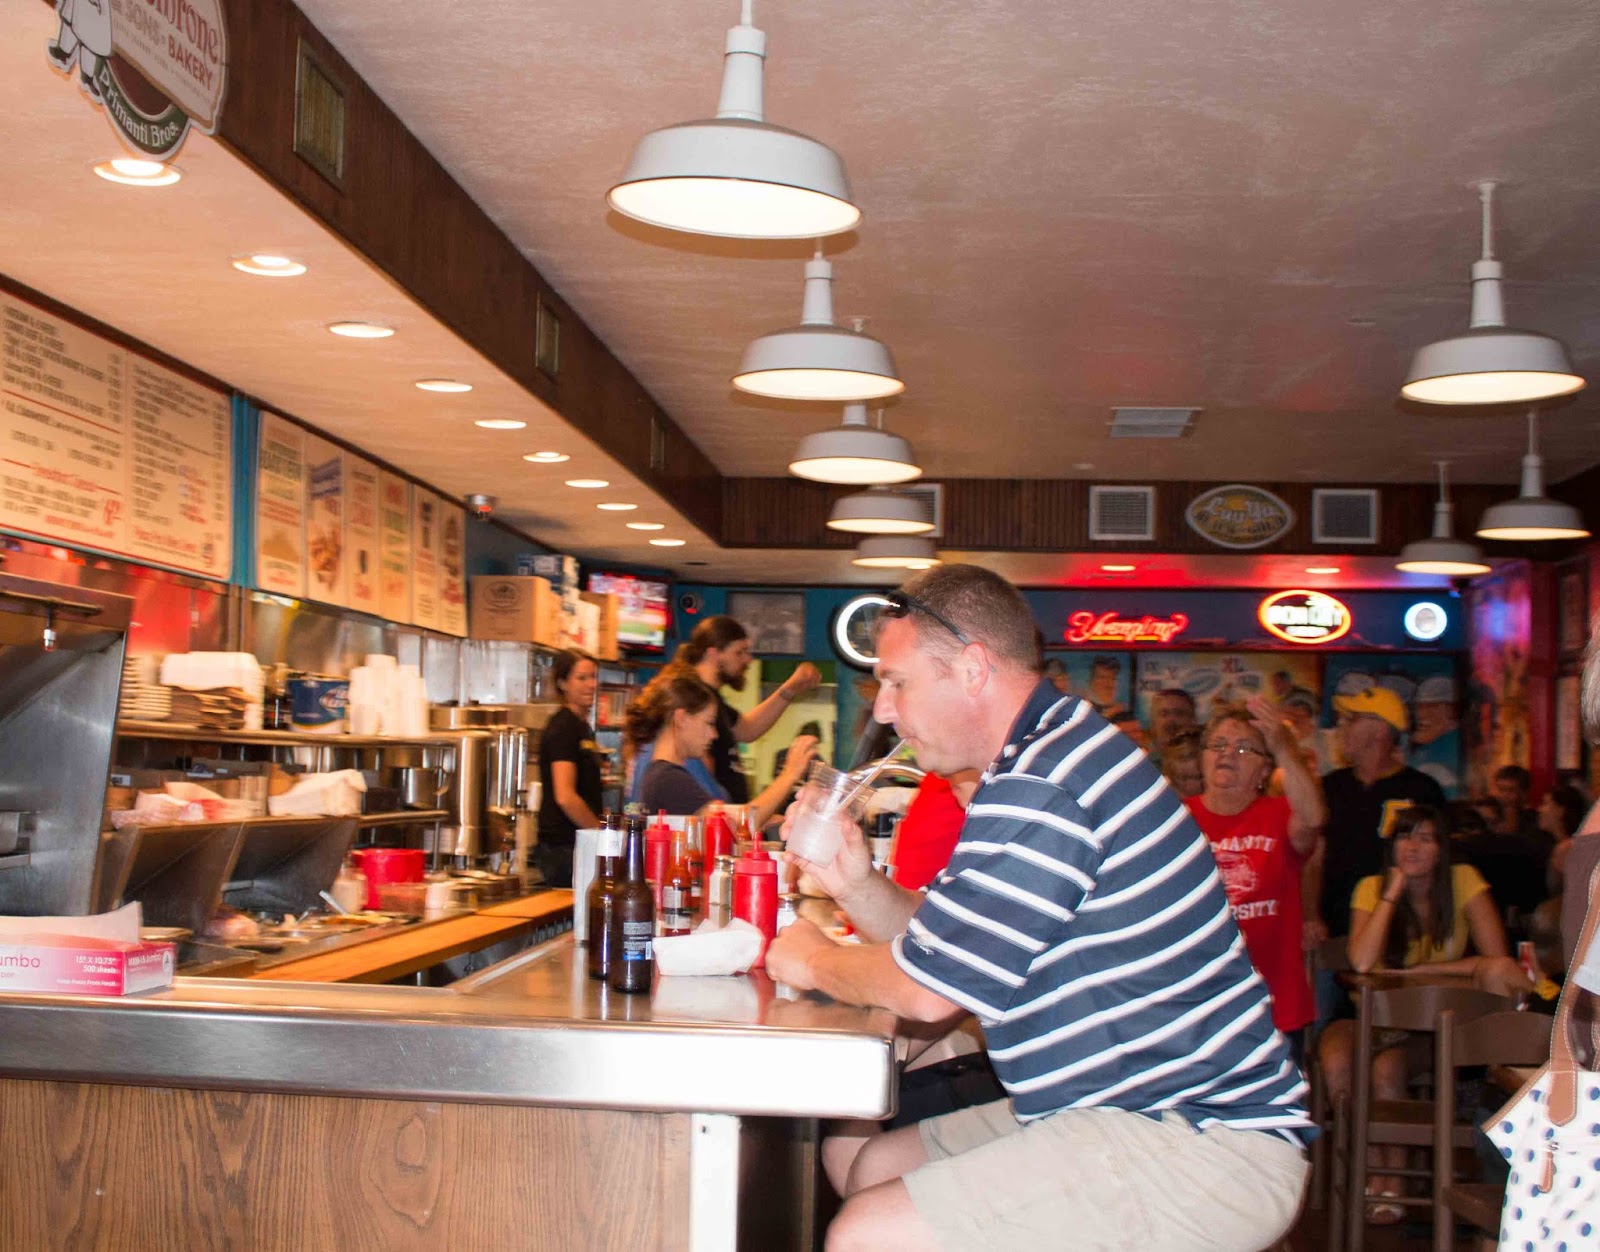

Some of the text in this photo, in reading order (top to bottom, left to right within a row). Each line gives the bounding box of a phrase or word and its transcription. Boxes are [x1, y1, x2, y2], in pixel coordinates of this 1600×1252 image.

[168, 32, 213, 91] BAKERY
[99, 65, 149, 145] Primanti
[1230, 900, 1276, 920] RSITY
[0, 954, 41, 968] mbo
[83, 965, 95, 973] 500
